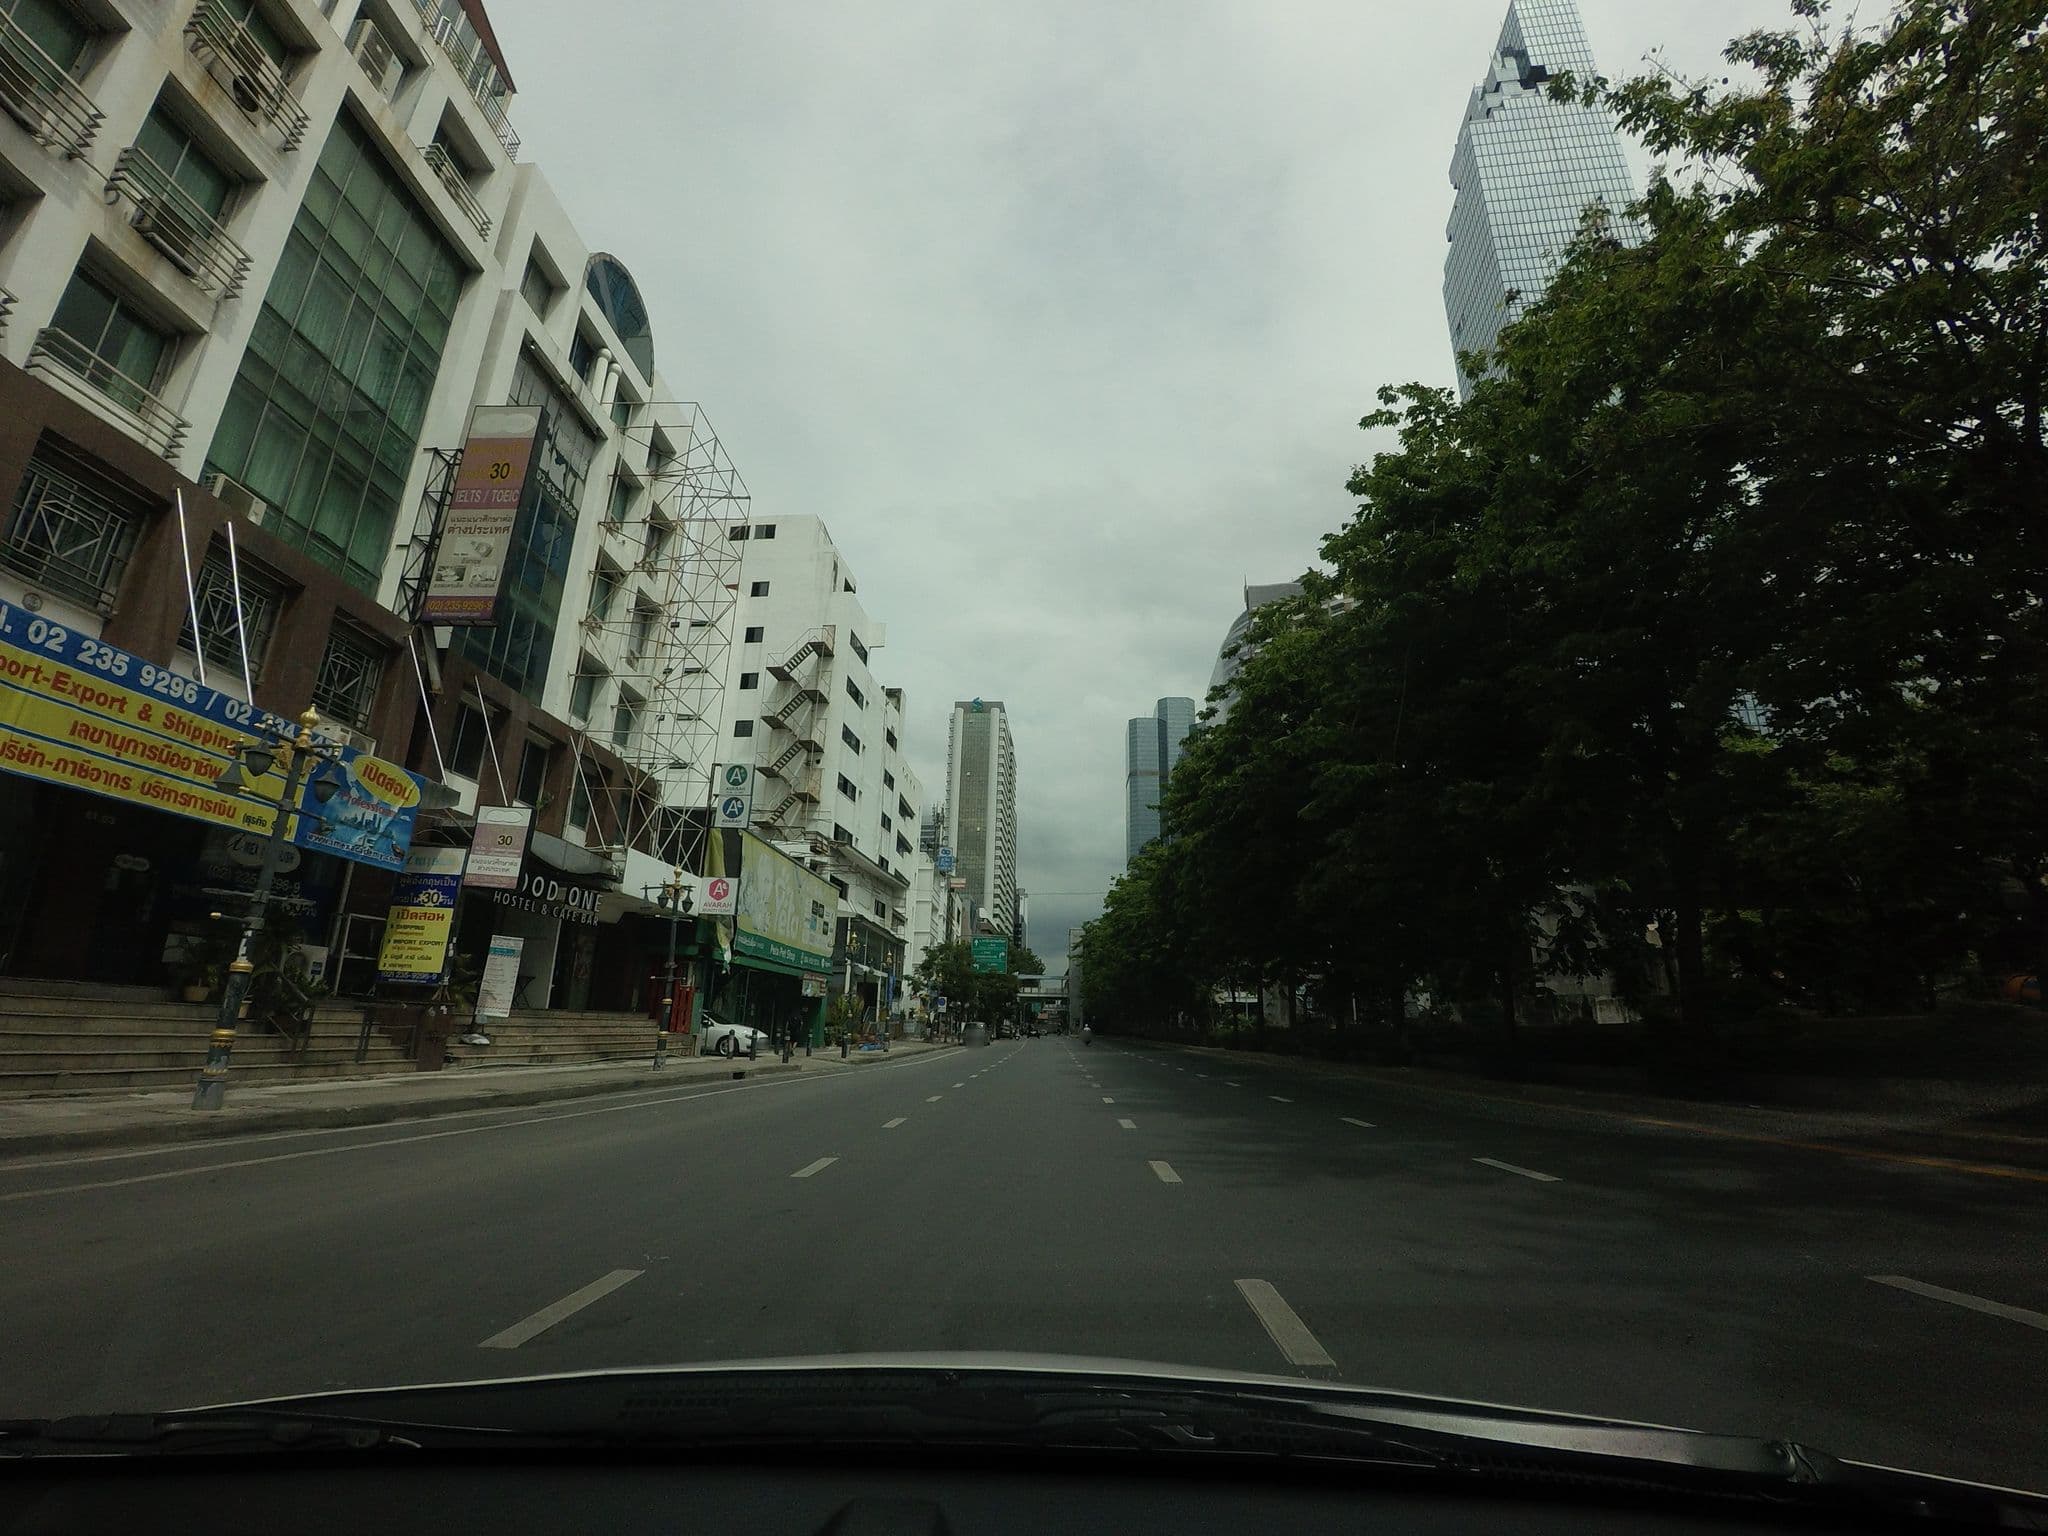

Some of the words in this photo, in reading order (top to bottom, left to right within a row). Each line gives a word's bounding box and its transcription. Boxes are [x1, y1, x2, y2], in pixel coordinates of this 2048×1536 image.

[490, 462, 511, 480] 30
[455, 489, 482, 503] IELTS
[491, 489, 521, 503] TOEIC
[447, 524, 511, 535] ต่างประเทศ
[27, 620, 68, 654] 02
[76, 640, 130, 677] 235
[139, 665, 199, 705] 9296
[224, 700, 254, 725] 02
[138, 703, 153, 723] &
[362, 763, 413, 802] เปิดสอน
[140, 780, 238, 821] บริหารการเงิน
[498, 835, 514, 845] 30
[421, 892, 441, 905] 30
[568, 886, 603, 913] ONE
[396, 909, 445, 922] เปิดสอน
[492, 890, 537, 913] HOSTEL
[540, 903, 549, 916] &
[552, 906, 577, 922] CAFE
[581, 912, 600, 927] BAR
